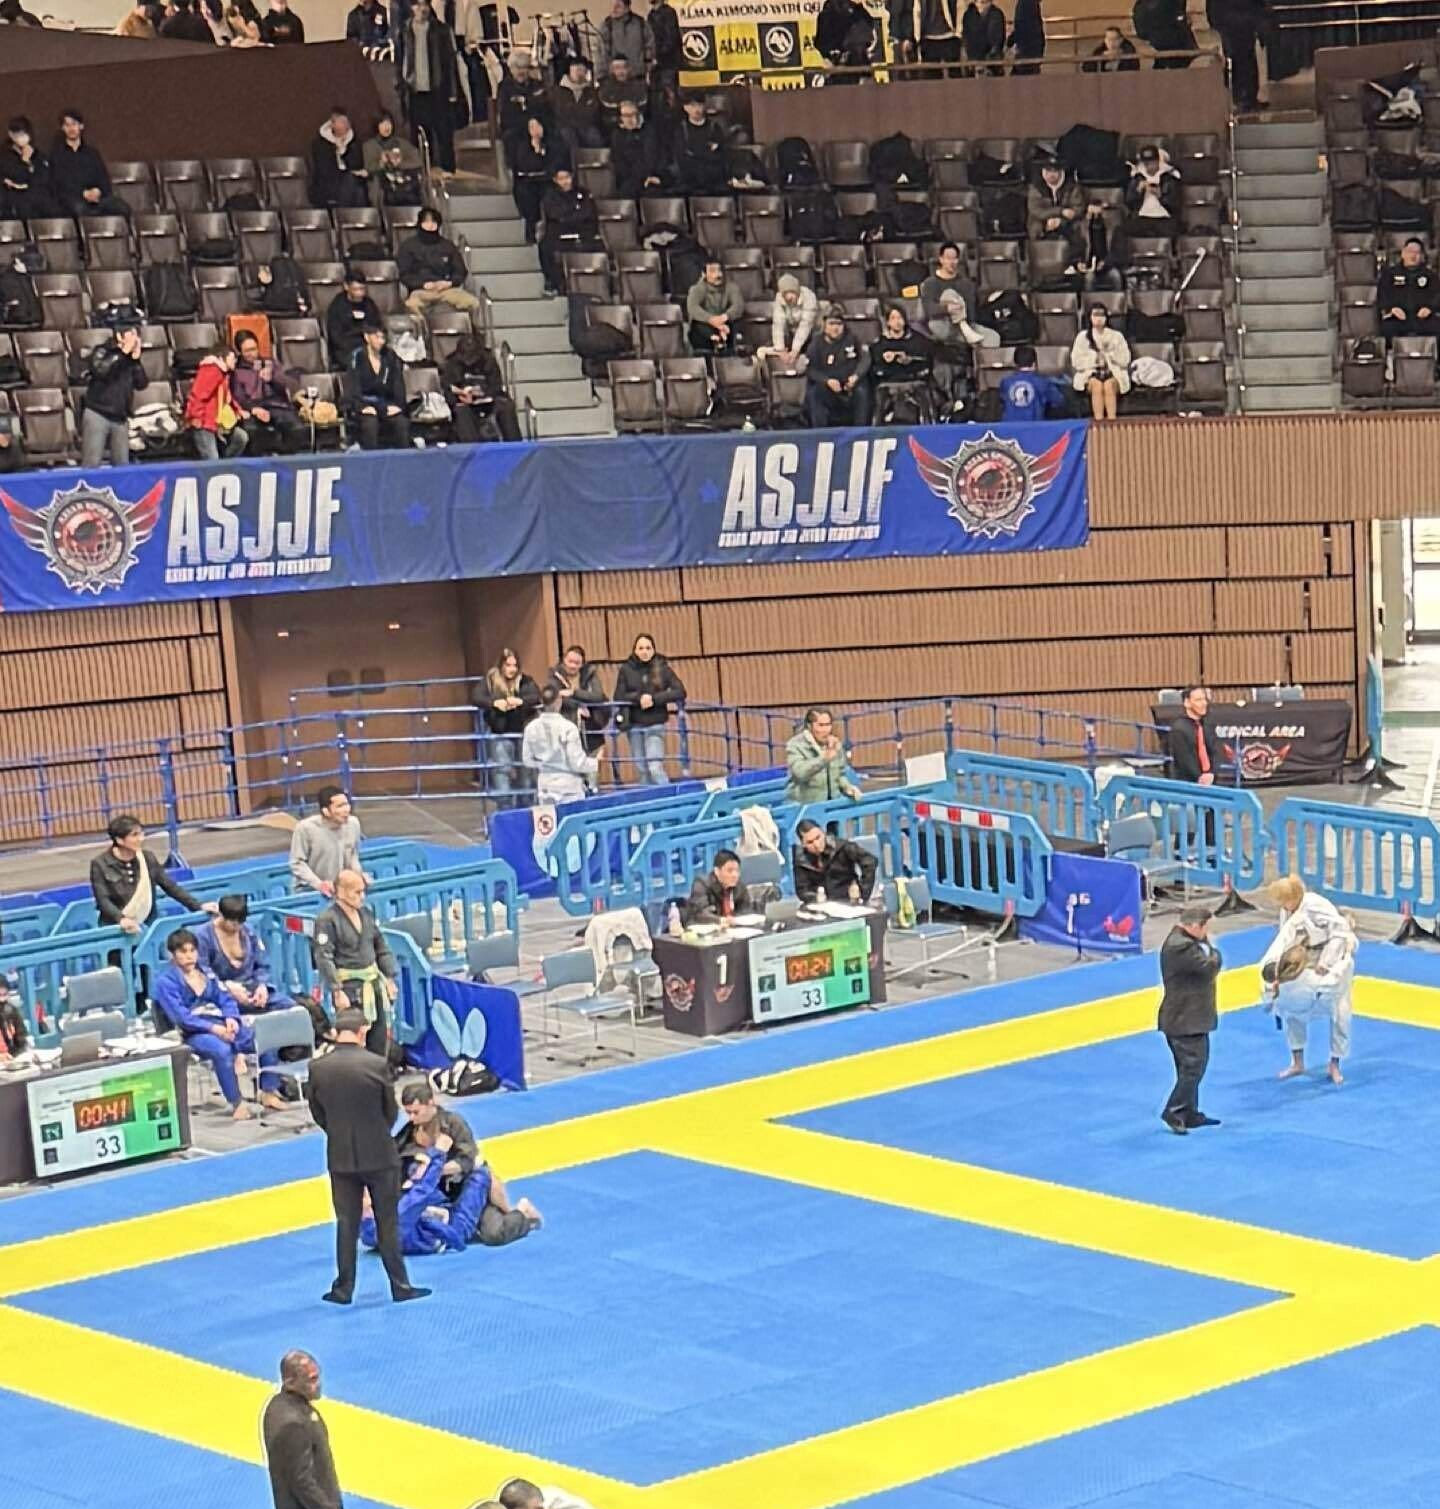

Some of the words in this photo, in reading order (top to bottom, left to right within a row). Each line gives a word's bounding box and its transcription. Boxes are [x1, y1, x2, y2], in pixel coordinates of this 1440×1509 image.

[720, 38, 757, 54] ALMA
[722, 438, 897, 530] ASJJF
[167, 466, 342, 567] ASJJF
[1269, 725, 1305, 738] AREA
[716, 953, 729, 985] 1
[802, 989, 823, 1009] 33
[80, 1099, 128, 1126] 00:41
[96, 1135, 121, 1158] 33
